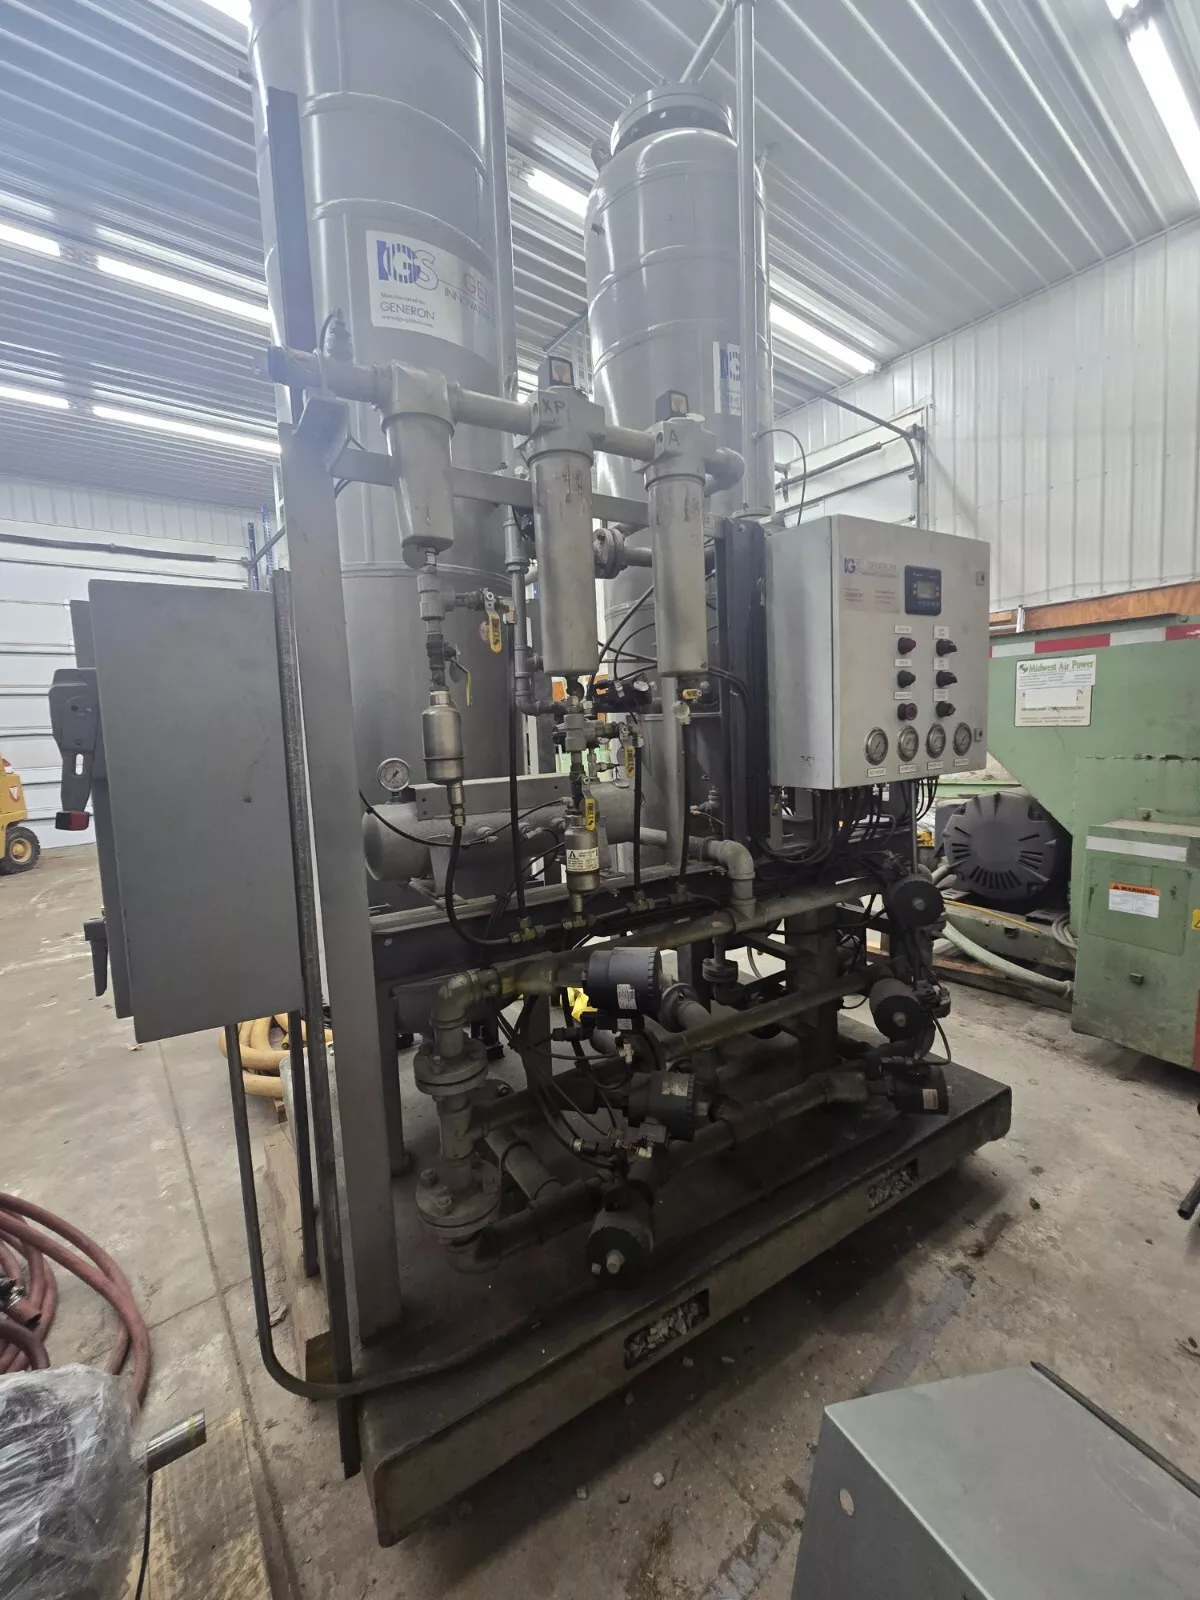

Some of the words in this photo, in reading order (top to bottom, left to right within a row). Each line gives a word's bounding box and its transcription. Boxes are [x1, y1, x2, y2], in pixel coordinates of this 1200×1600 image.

[379, 300, 435, 321] GENERON
[668, 429, 681, 447] A
[1028, 663, 1057, 672] Midwest
[1058, 661, 1070, 671] Air
[1071, 660, 1094, 669] Power
[1121, 886, 1156, 895] WARNING
